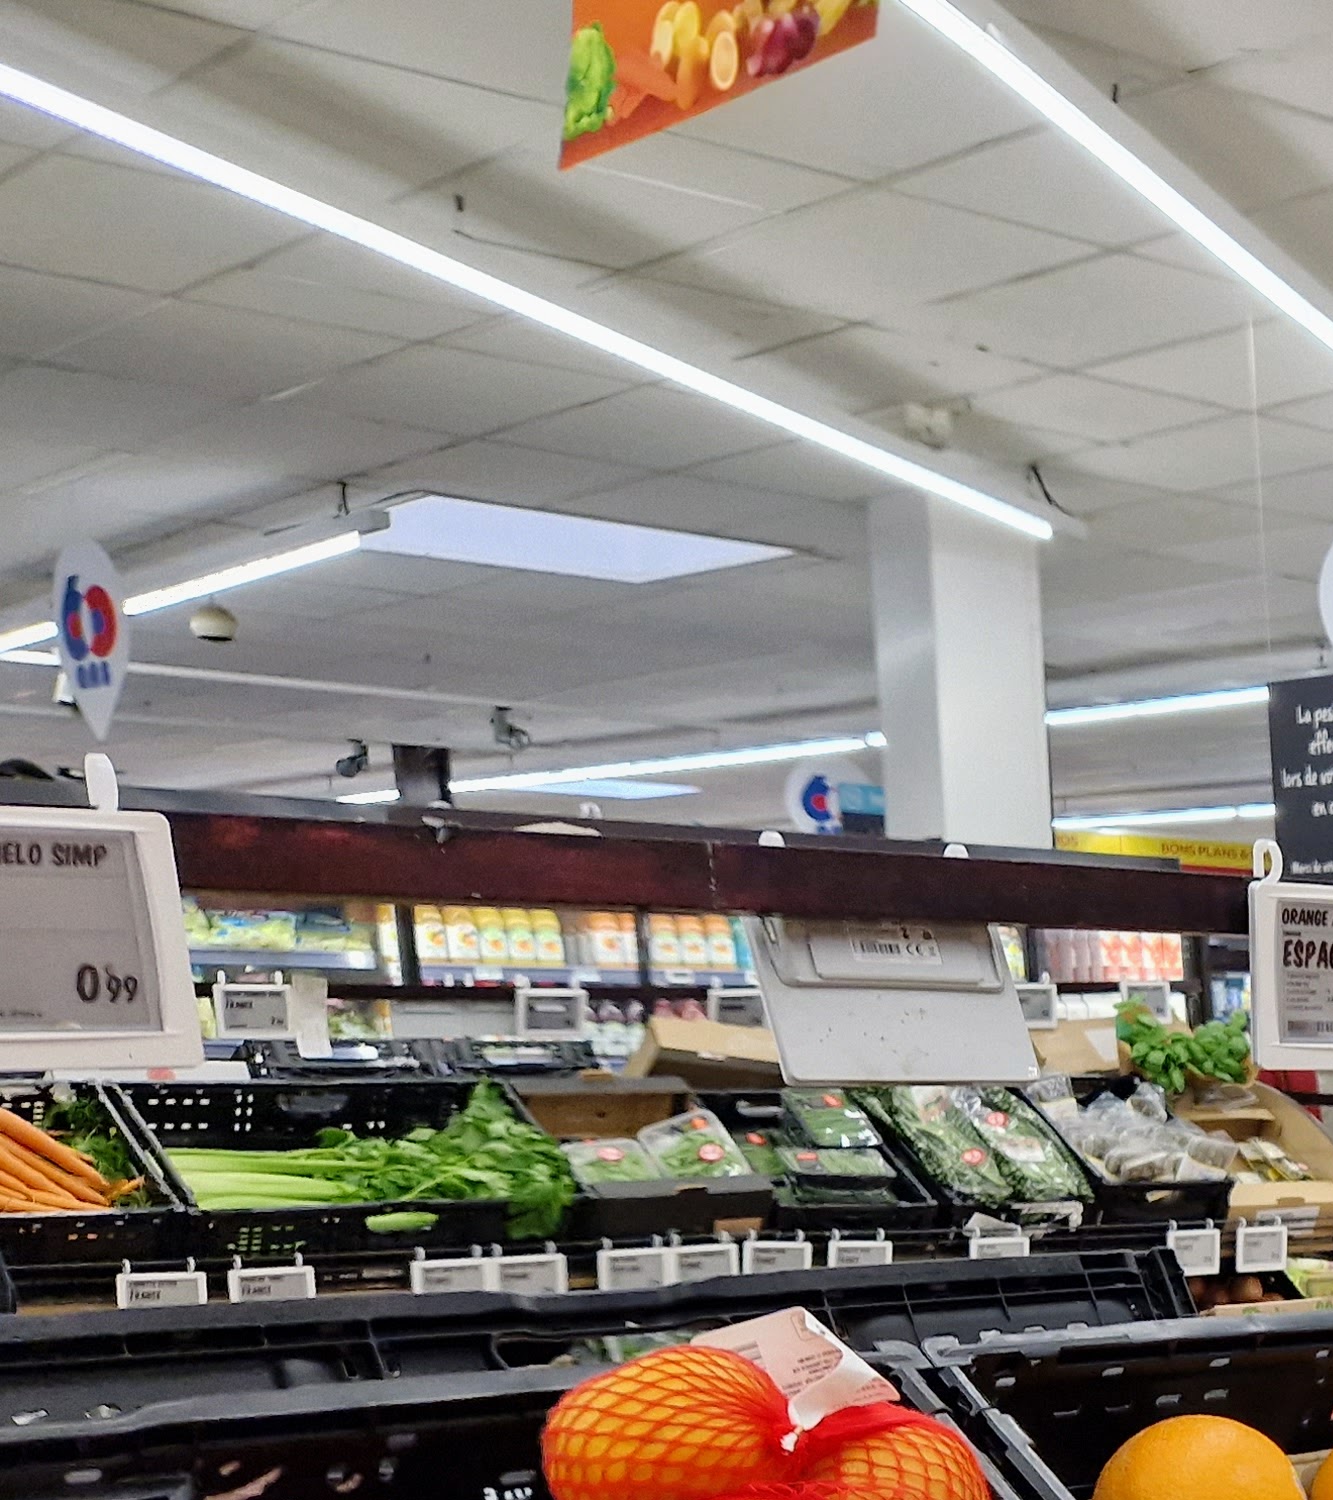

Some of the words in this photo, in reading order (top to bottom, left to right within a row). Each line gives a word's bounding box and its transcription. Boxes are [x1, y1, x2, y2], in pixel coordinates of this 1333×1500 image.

[1296, 704, 1312, 725] La
[1280, 768, 1303, 789] lors
[1304, 764, 1317, 786] de
[1310, 802, 1327, 817] en
[0, 842, 42, 866] ELO
[52, 843, 108, 868] SIMP
[1282, 908, 1328, 928] ORANGE
